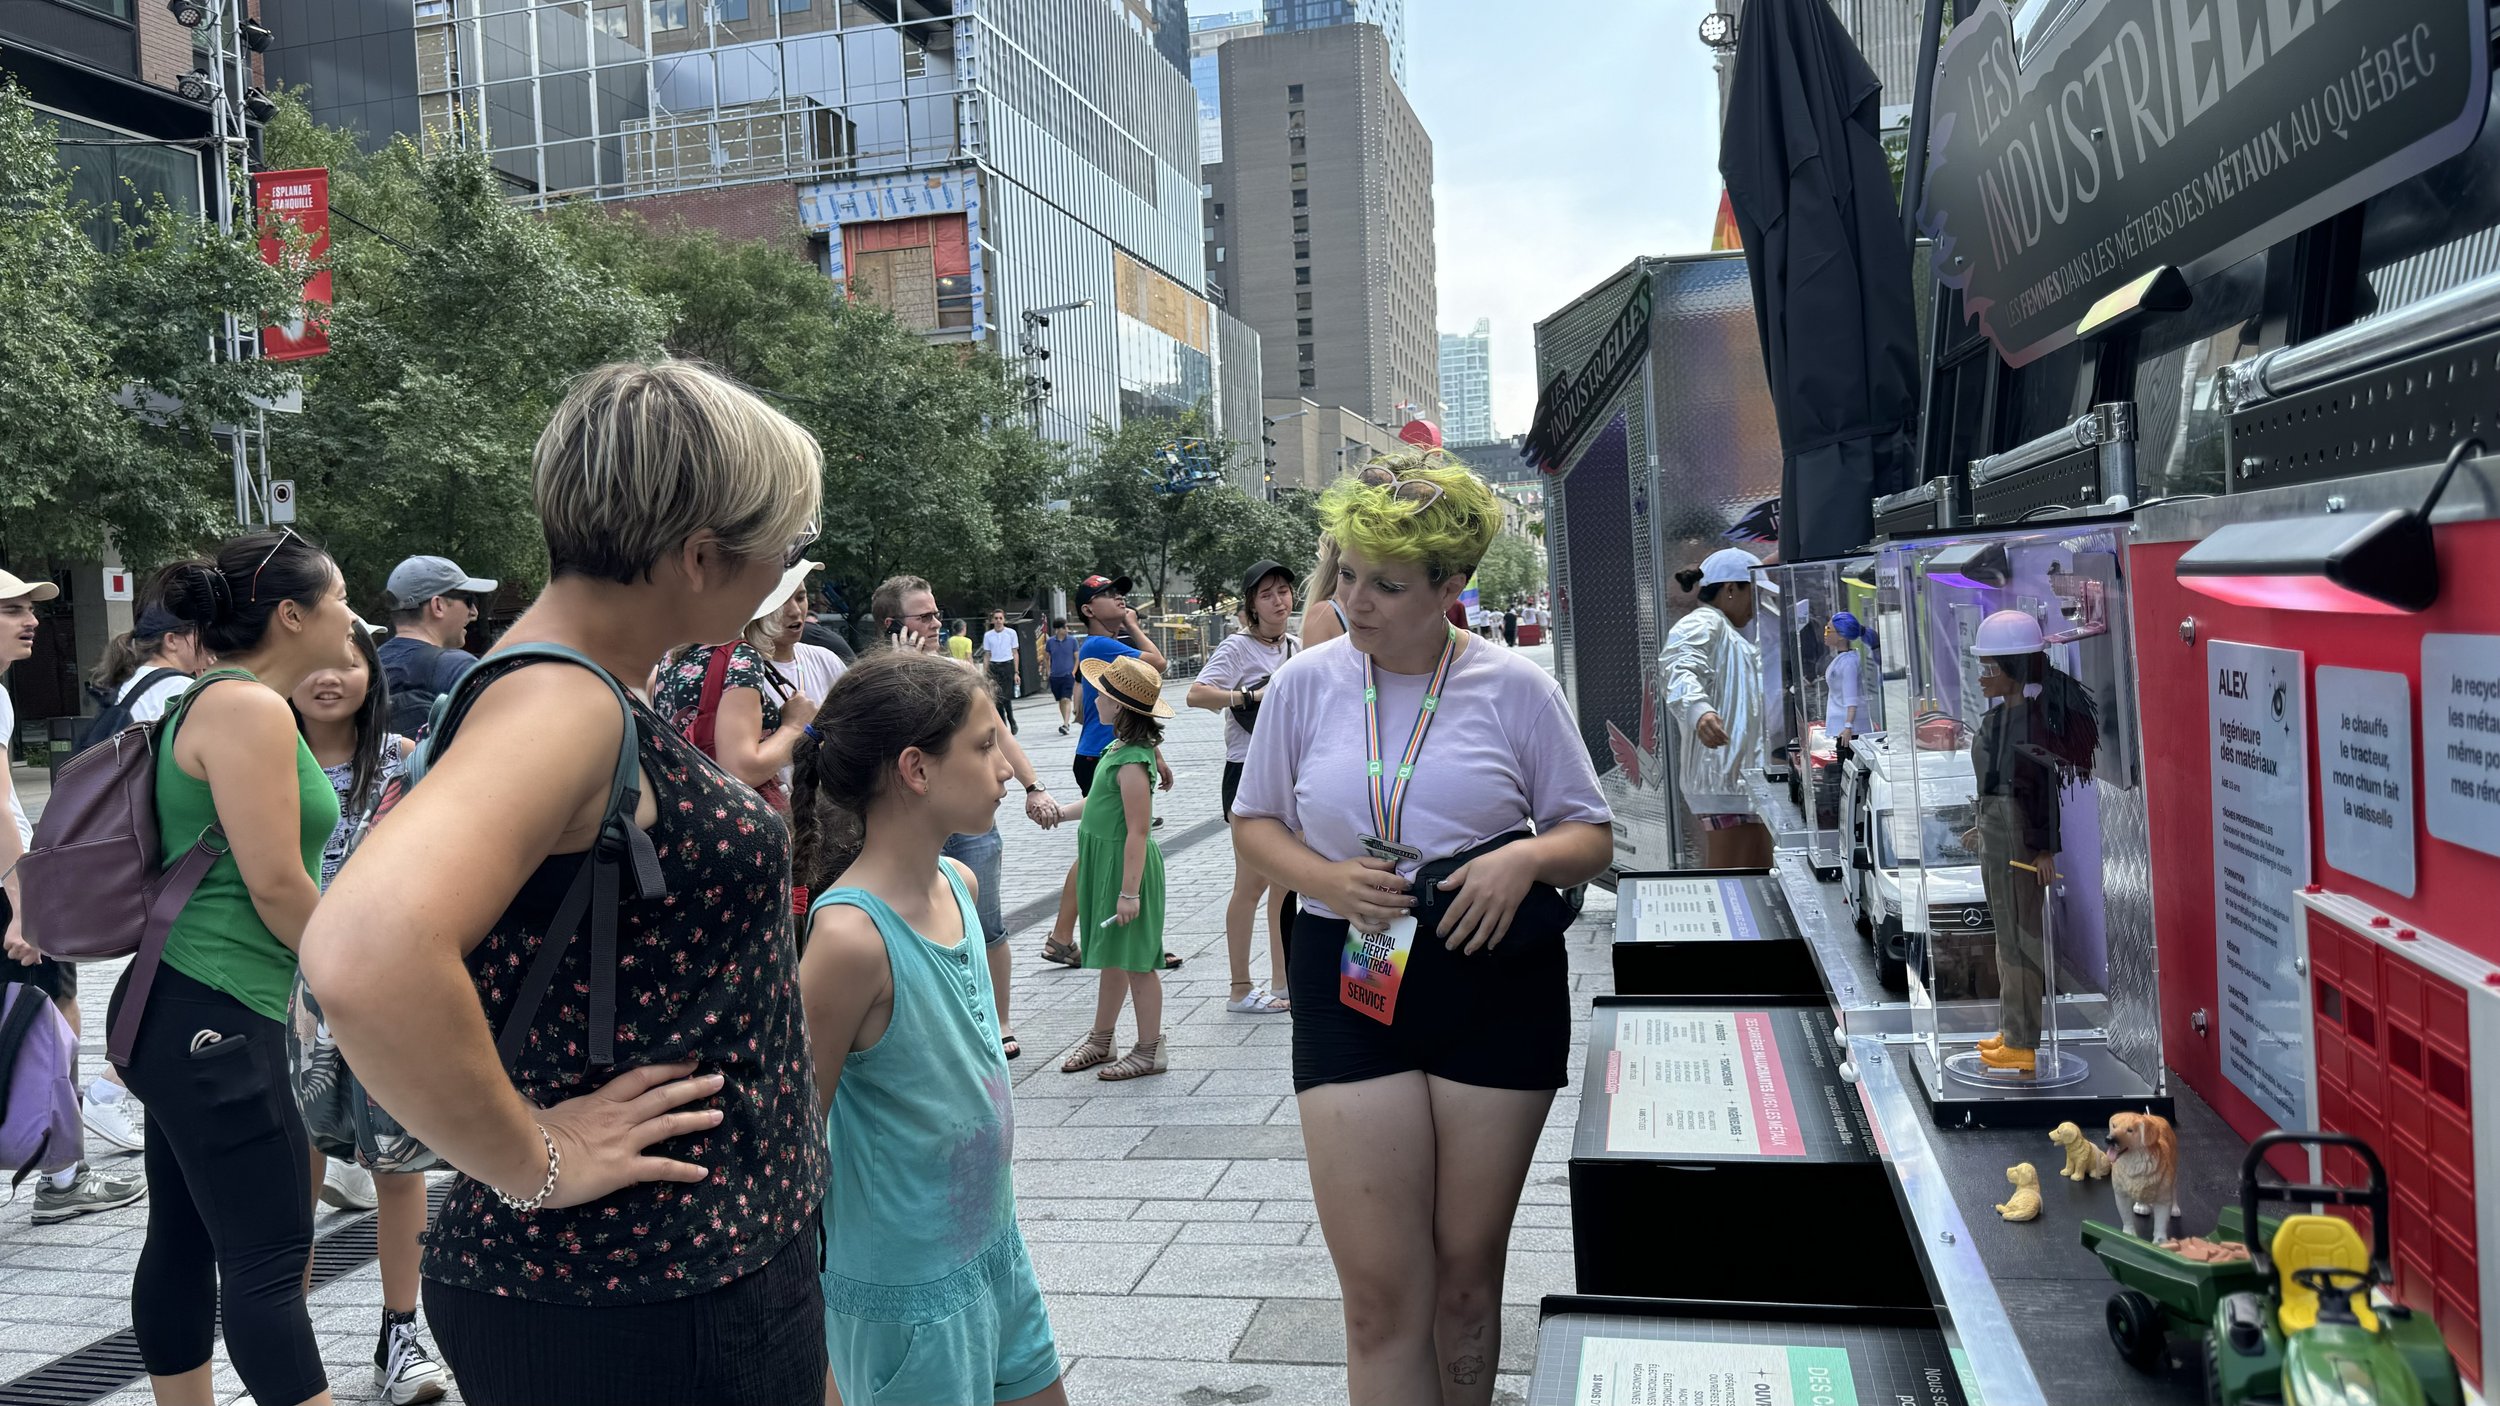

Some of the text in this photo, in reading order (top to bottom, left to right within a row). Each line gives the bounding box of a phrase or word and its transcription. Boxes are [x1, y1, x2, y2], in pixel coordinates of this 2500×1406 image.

[1968, 36, 2012, 147] LES
[2020, 271, 2062, 320] FEMMES
[2060, 252, 2092, 295] DANS
[2090, 237, 2116, 277] LES
[2114, 213, 2174, 265] MÉTIERS
[2172, 178, 2205, 229] DES
[2203, 146, 2289, 211] MÉTAUX
[2290, 98, 2321, 158] AU
[2324, 22, 2436, 140] QUÉBEC
[271, 196, 313, 211] TRANQUILLE
[272, 184, 312, 198] ESPLANADE
[1549, 283, 1650, 446] INDUSTRIELLES
[1551, 374, 1567, 410] LES
[2219, 668, 2249, 700] ALEX
[2451, 674, 2462, 695] Je
[2341, 713, 2388, 738] Je chauffe
[2448, 706, 2464, 728] les
[2219, 718, 2261, 746] Ingénieure
[2220, 741, 2278, 777] des matériaux
[2340, 740, 2390, 772] le tracteur,
[2447, 740, 2483, 767] même
[2333, 770, 2400, 801] mon chum fait
[2451, 777, 2474, 800] mes
[2344, 797, 2393, 829] la vaisselle
[1347, 981, 1387, 1013] SERVICE
[1719, 1058, 1734, 1085] TECHNICIENNES
[1744, 1018, 1790, 1146] DES CARRIÈRES HALLUCINANTES AVEC LES MÉTAUX
[1823, 1085, 1836, 1096] Nous
[1826, 1096, 1839, 1109] avons
[1727, 1107, 1744, 1135] INGÉNIEURES
[1831, 1116, 1848, 1131] temps
[1591, 1382, 1603, 1398] MOIS
[1593, 1373, 1604, 1382] 18
[1631, 1363, 1645, 1405] MÉCANICIENNES
[1709, 1373, 1720, 1403] OUVRIÈRES
[1807, 1367, 1833, 1392] DES
[1923, 1368, 1946, 1393] Nous
